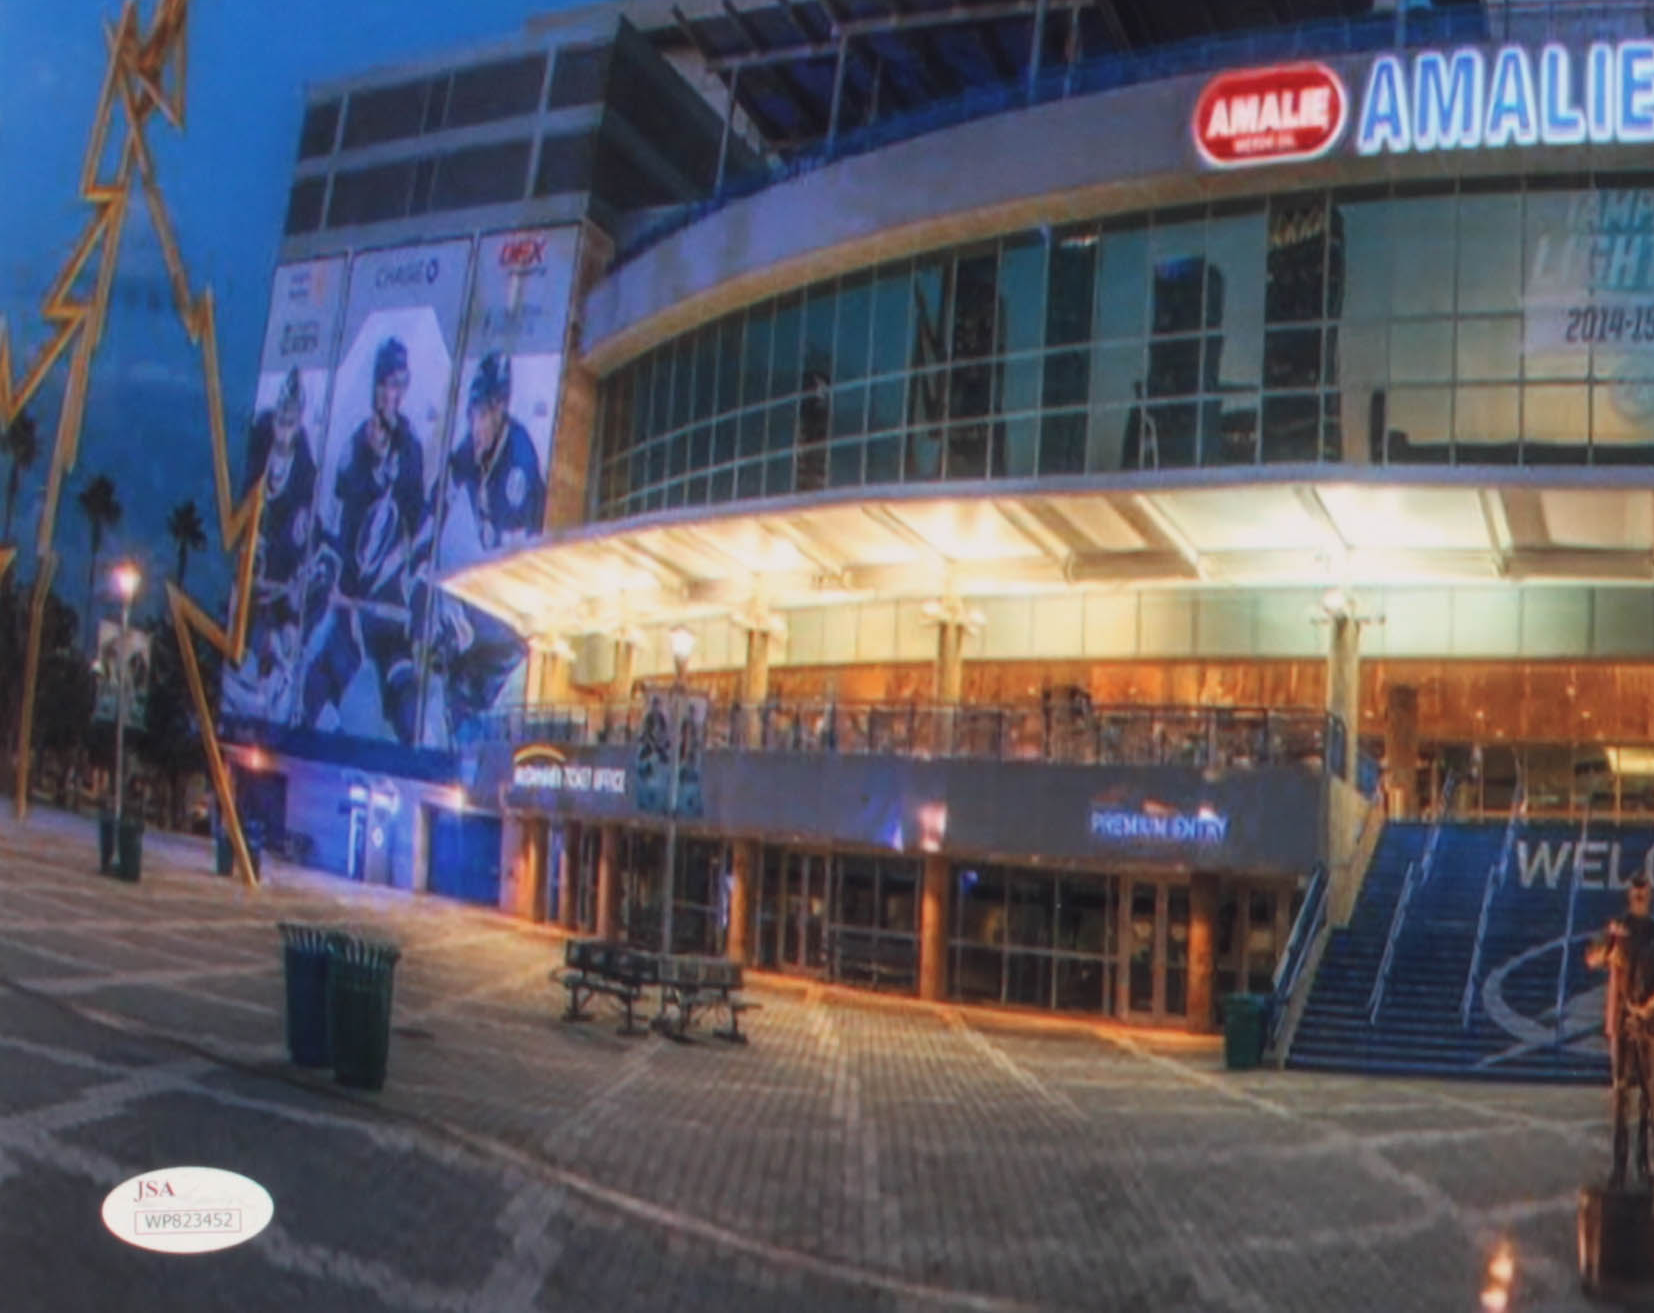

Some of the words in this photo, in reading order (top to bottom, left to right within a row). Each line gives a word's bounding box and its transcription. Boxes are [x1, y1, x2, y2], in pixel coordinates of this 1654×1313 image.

[1205, 85, 1331, 140] AMALIE
[133, 1179, 175, 1203] JSA
[144, 1212, 234, 1229] WP823452
